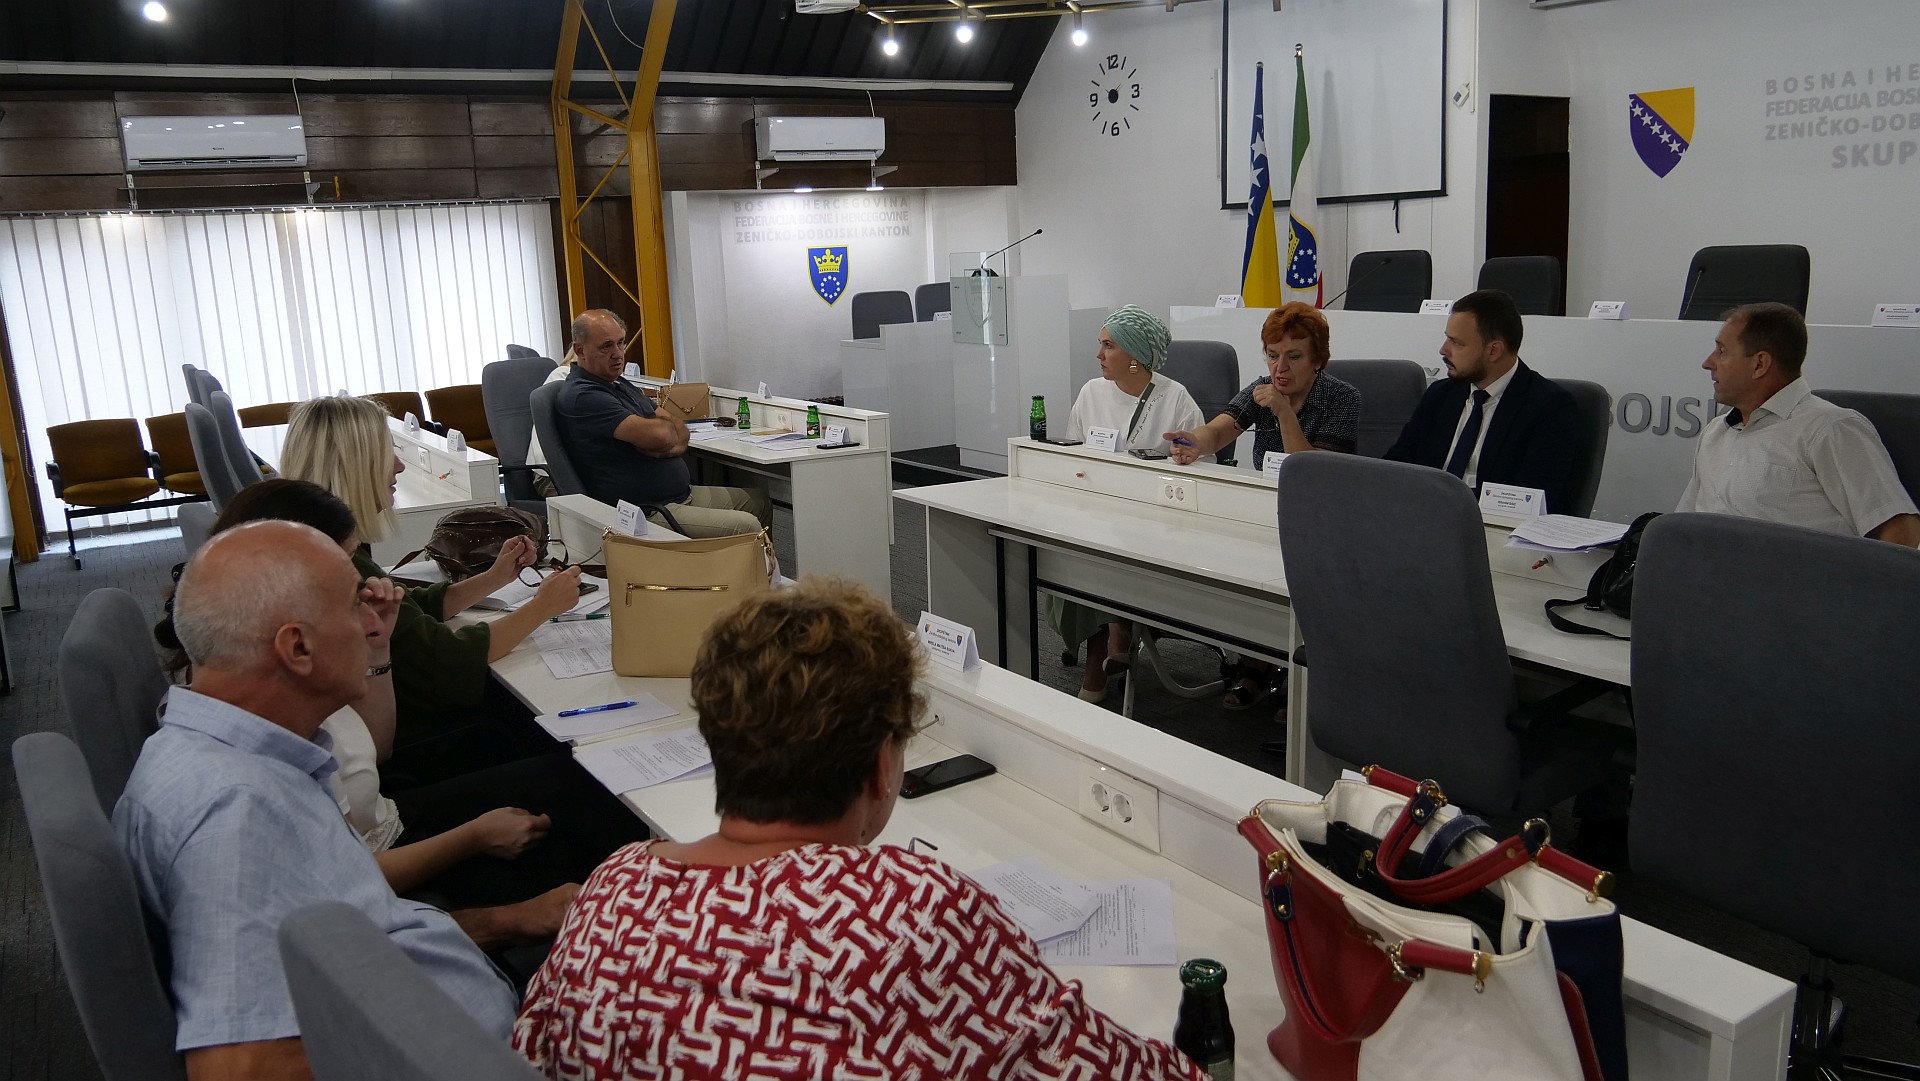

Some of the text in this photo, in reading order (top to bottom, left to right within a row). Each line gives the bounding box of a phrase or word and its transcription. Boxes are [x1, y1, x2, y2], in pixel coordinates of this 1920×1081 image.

[1106, 54, 1119, 70] 12
[1765, 71, 1856, 96] BOSNA
[1868, 68, 1873, 85] I
[1131, 84, 1140, 98] 3
[1090, 93, 1098, 107] 9
[1765, 87, 1920, 118] FEDERACIJA BOS
[1111, 122, 1120, 136] 6
[1831, 140, 1918, 169] SKUP
[734, 201, 788, 213] BOSNA
[801, 197, 909, 211] HERCEGOVINA
[735, 214, 796, 228] FEDERACIJA
[799, 213, 833, 225] BOSNE
[842, 211, 909, 223] HERCEGOVINE
[862, 226, 910, 238] KANTON
[1609, 392, 1733, 438] OJS
